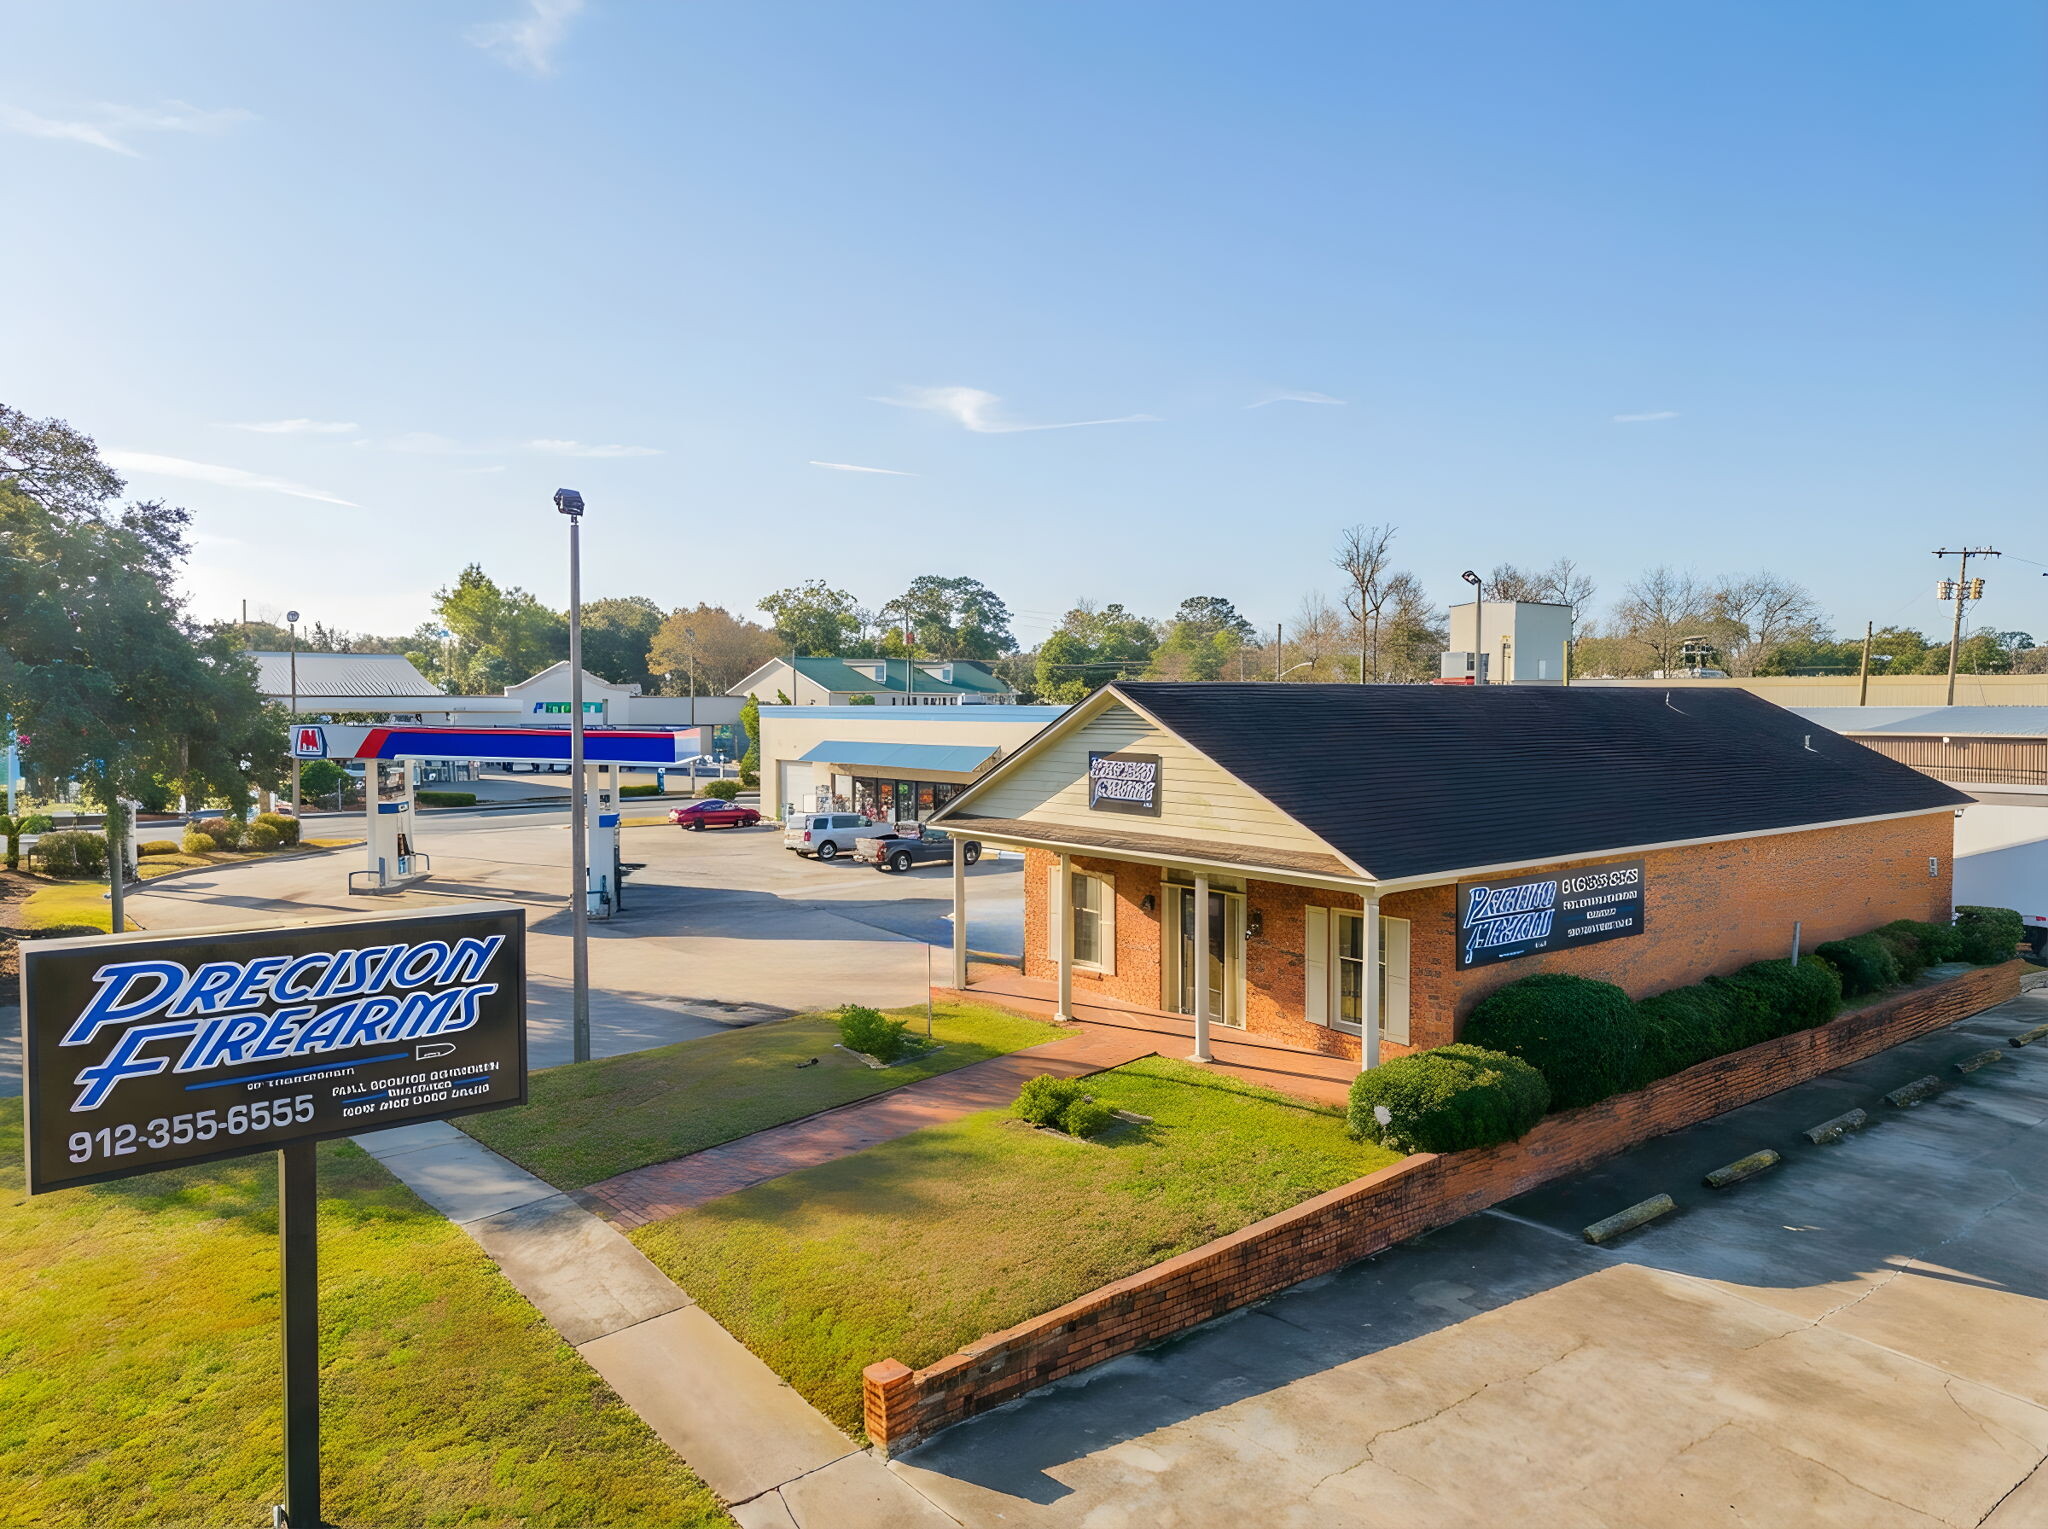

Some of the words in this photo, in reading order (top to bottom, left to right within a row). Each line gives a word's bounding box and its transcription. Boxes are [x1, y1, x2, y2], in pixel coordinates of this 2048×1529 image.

[59, 934, 506, 1047] PRECISION
[70, 983, 499, 1112] FIREARMS
[68, 1094, 315, 1164] 912-355-6555
